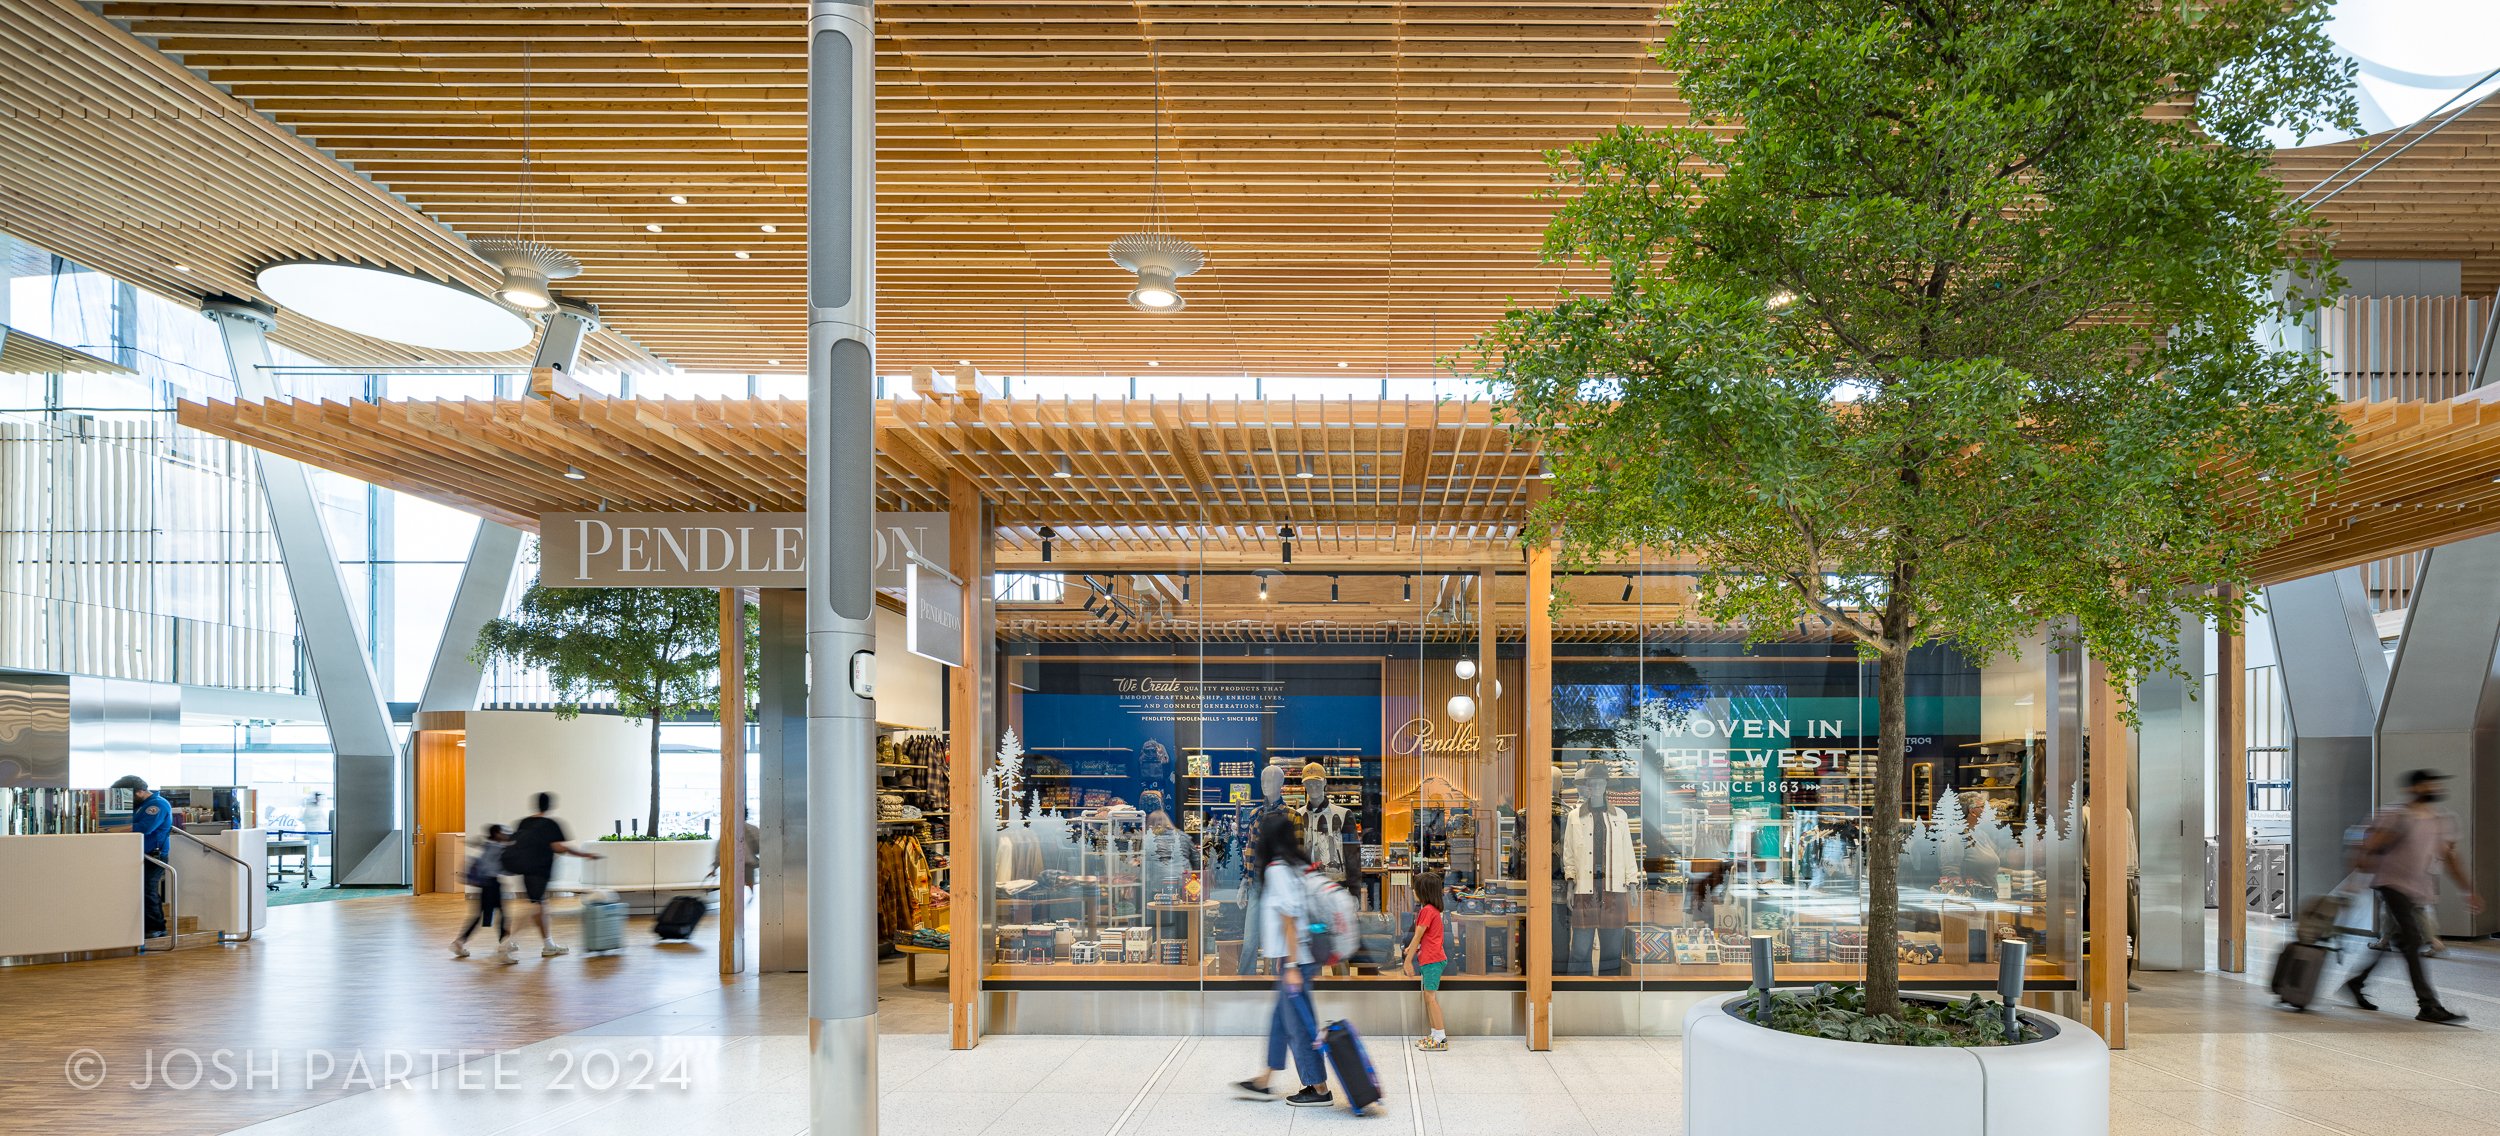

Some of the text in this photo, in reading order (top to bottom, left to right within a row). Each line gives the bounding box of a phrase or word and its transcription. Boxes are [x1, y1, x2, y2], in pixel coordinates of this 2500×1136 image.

[574, 519, 928, 580] PENDLEN
[920, 598, 961, 632] PENDLETON
[1113, 678, 1138, 692] We
[1141, 677, 1180, 692] Create
[1392, 718, 1517, 755] Pendletn
[1659, 719, 1843, 739] WOVEN IN
[1656, 749, 1847, 768] THE WEST
[1702, 781, 1799, 793] SINCE 1863
